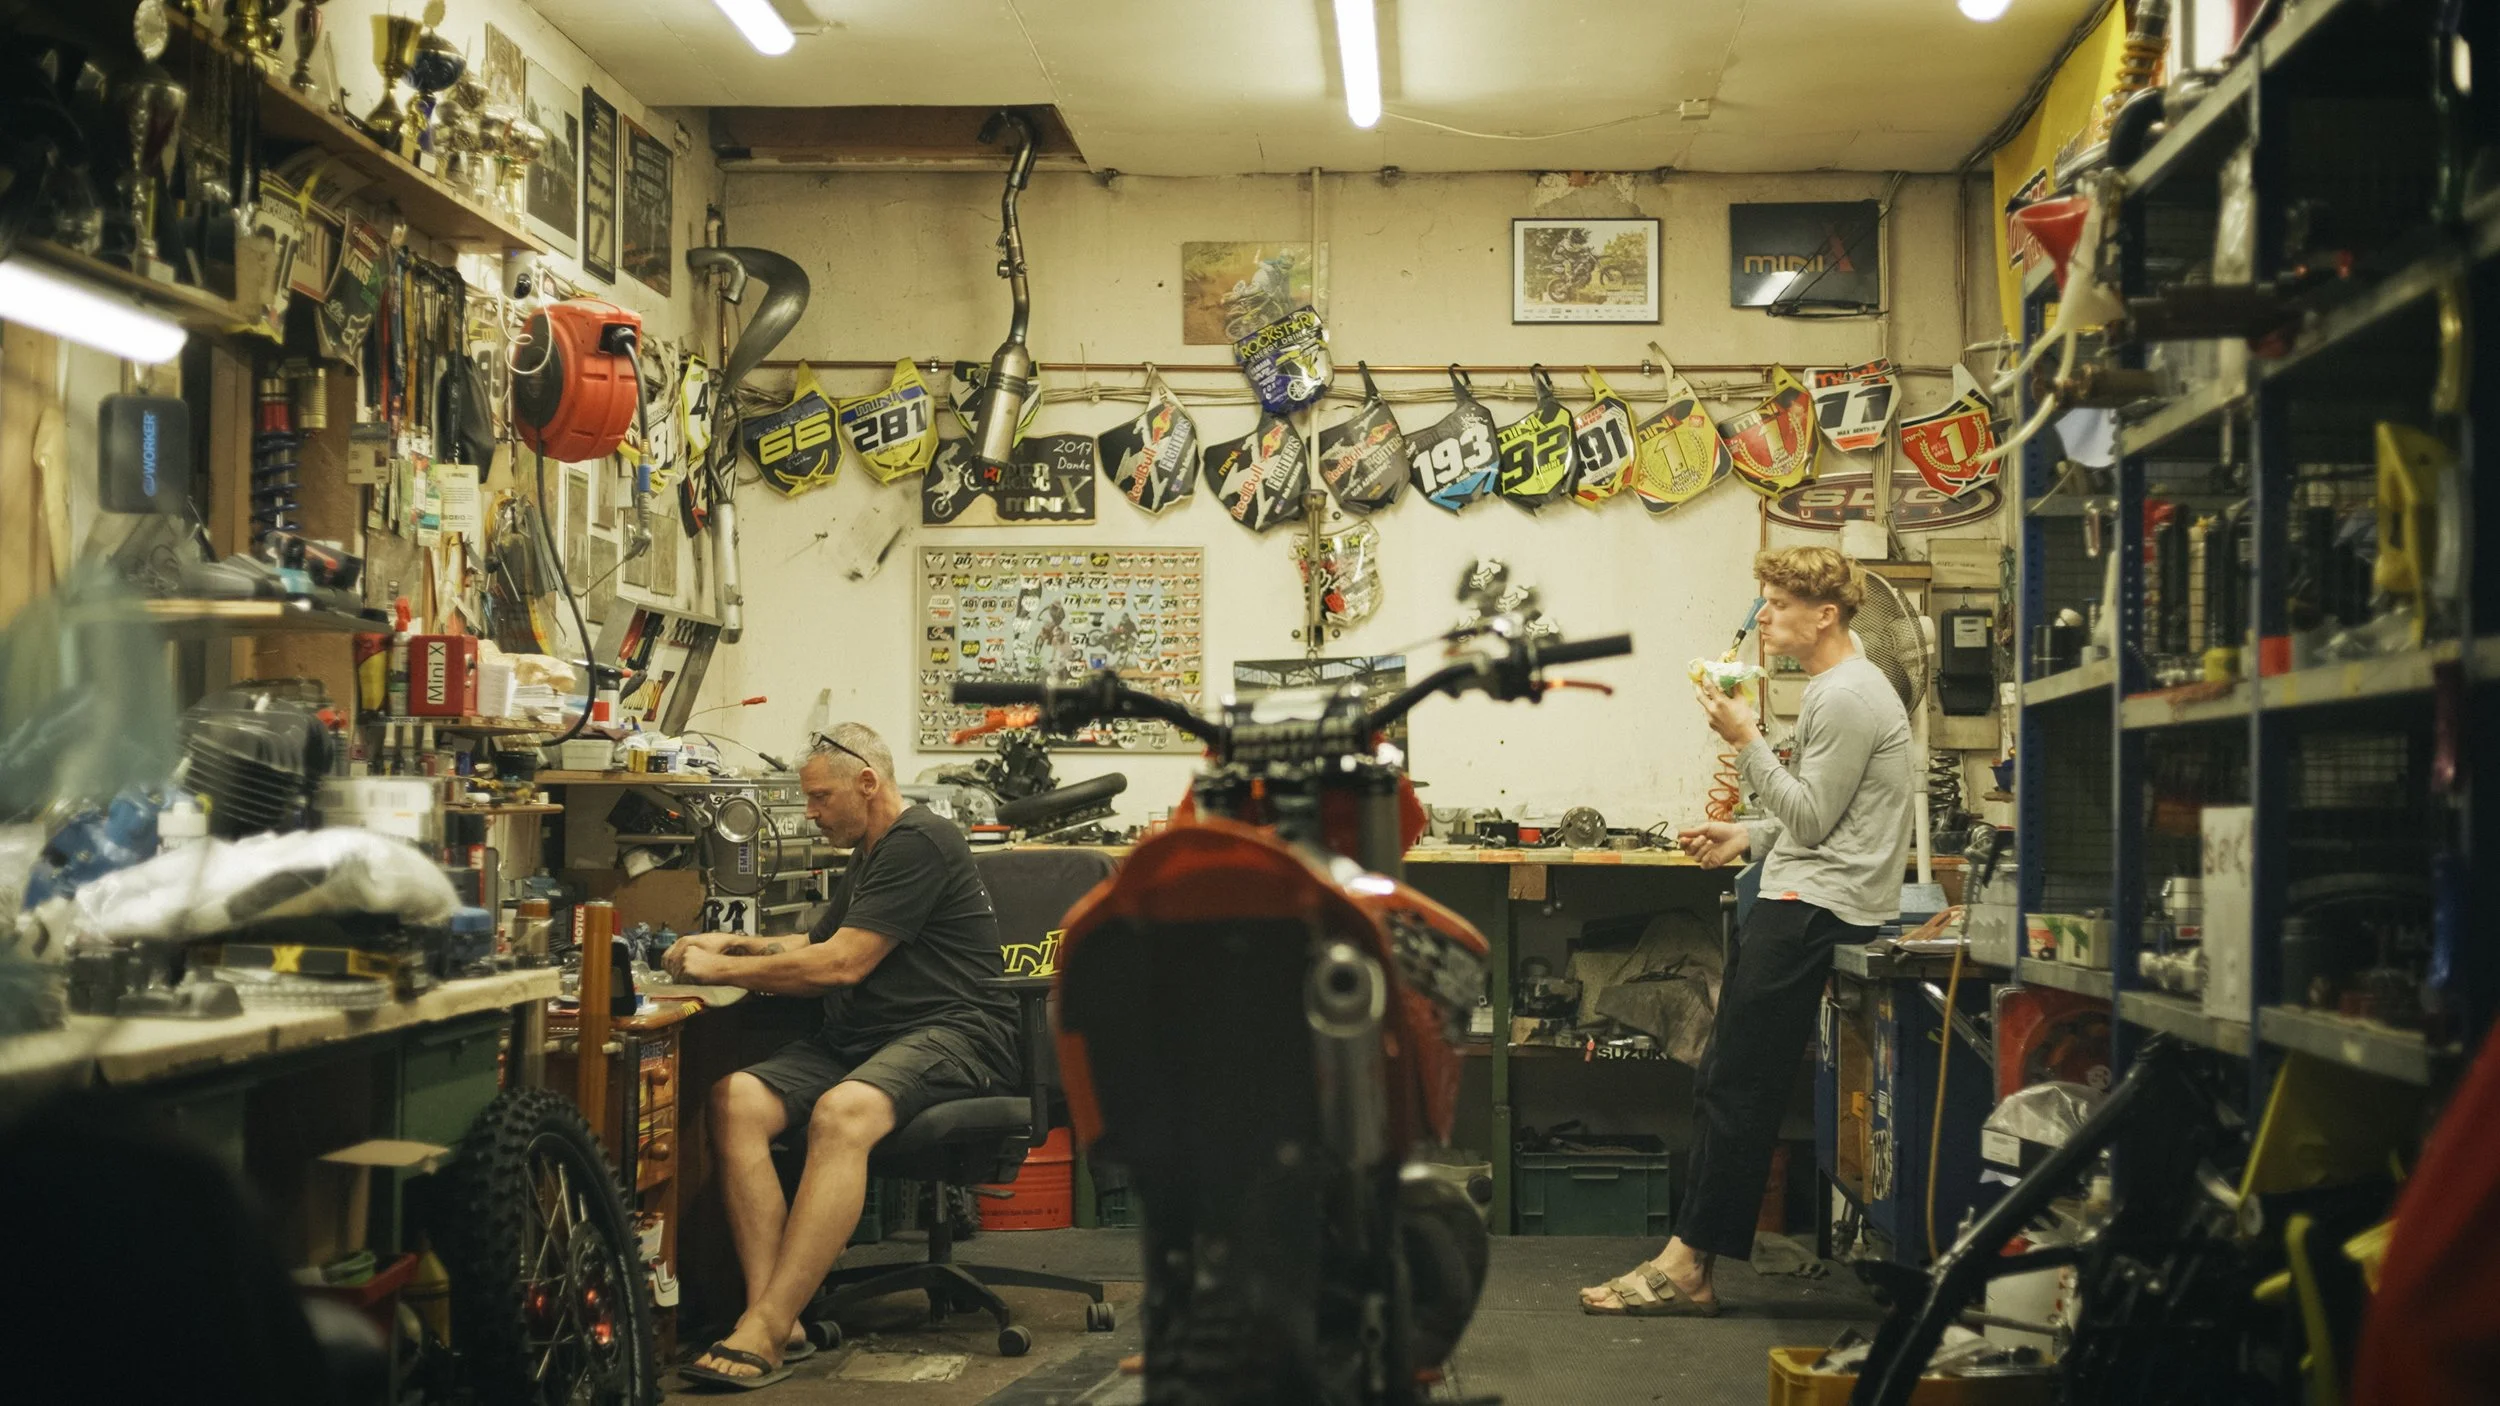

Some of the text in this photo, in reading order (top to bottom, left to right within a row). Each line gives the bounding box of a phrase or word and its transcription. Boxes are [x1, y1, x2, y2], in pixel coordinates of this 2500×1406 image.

[759, 411, 831, 464] 66
[852, 402, 927, 454] 281
[1053, 439, 1093, 455] 2017
[1941, 421, 1967, 465] 1
[1057, 457, 1091, 471] Danke
[1266, 435, 1302, 491] FIGHTERS
[1412, 423, 1492, 493] 193
[1501, 424, 1570, 493] 92
[428, 643, 445, 702] Mini X
[572, 905, 585, 945] MOTUL
